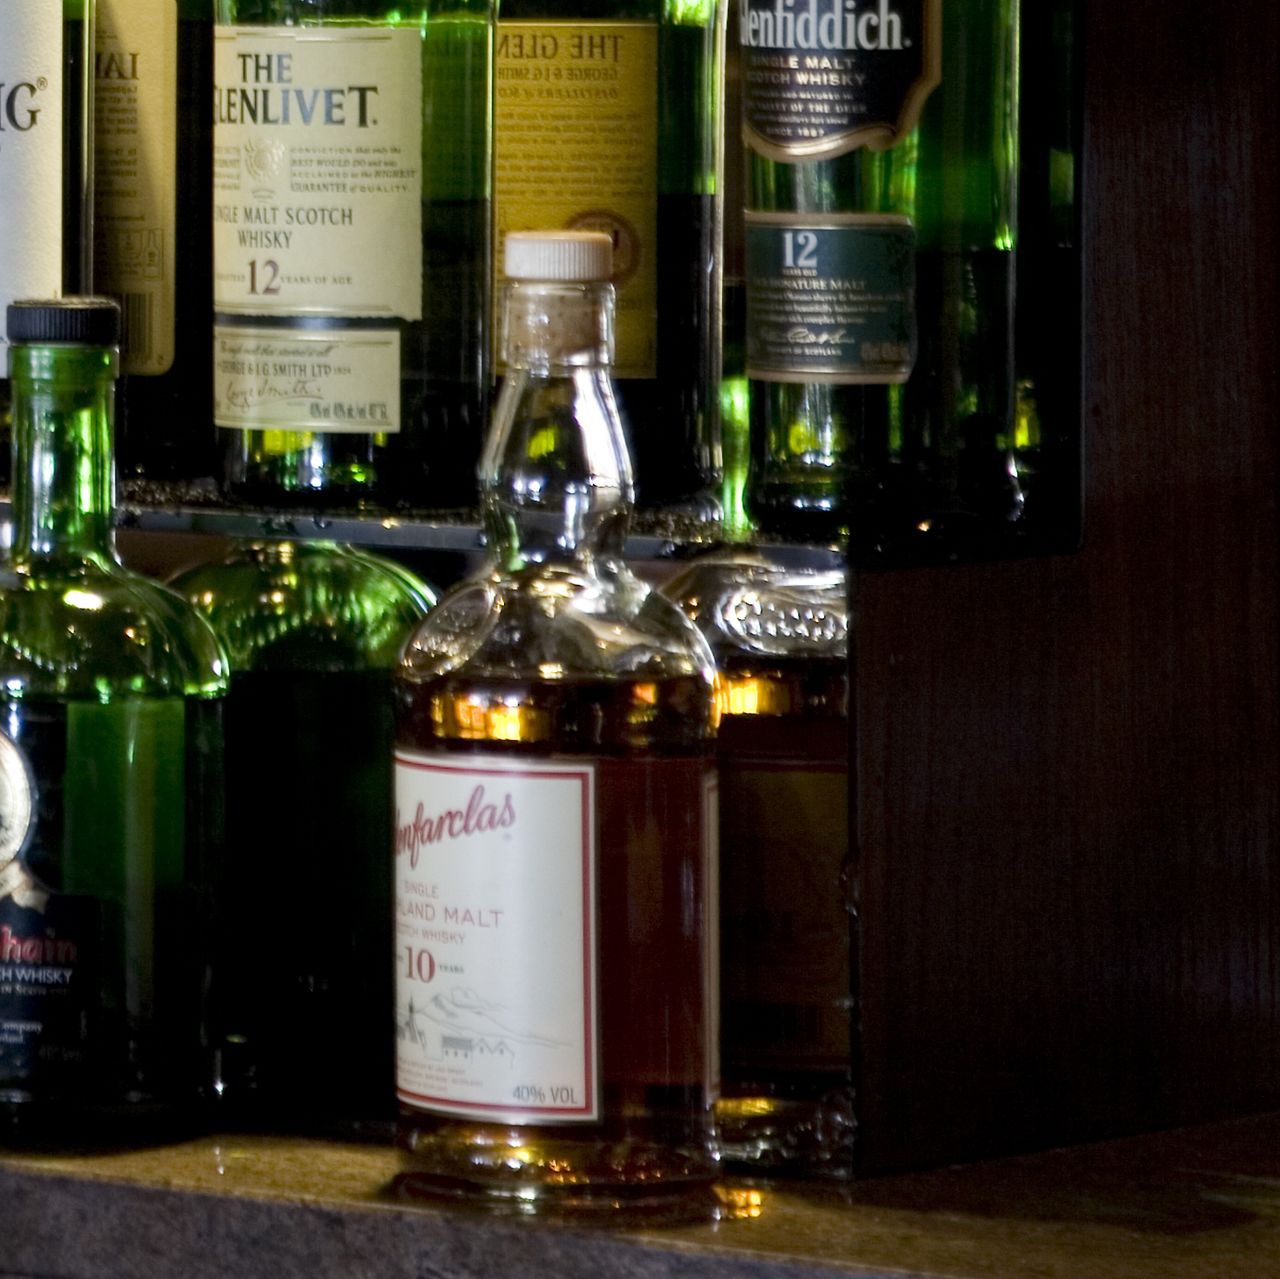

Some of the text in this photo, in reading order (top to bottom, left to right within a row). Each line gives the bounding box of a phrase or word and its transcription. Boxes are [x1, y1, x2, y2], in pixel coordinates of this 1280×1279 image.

[237, 54, 294, 84] THE
[795, 71, 867, 87] WHISKY
[243, 206, 354, 227] MALT SCOTCH
[237, 229, 293, 250] WHISKY
[782, 230, 819, 268] 12
[247, 258, 282, 297] 12
[271, 362, 308, 377] SMITH
[444, 906, 504, 929] MALT
[421, 928, 467, 945] WHISKY
[404, 945, 436, 984] 10
[15, 968, 73, 984] WHISKY
[512, 1084, 579, 1105] 40% VOL
